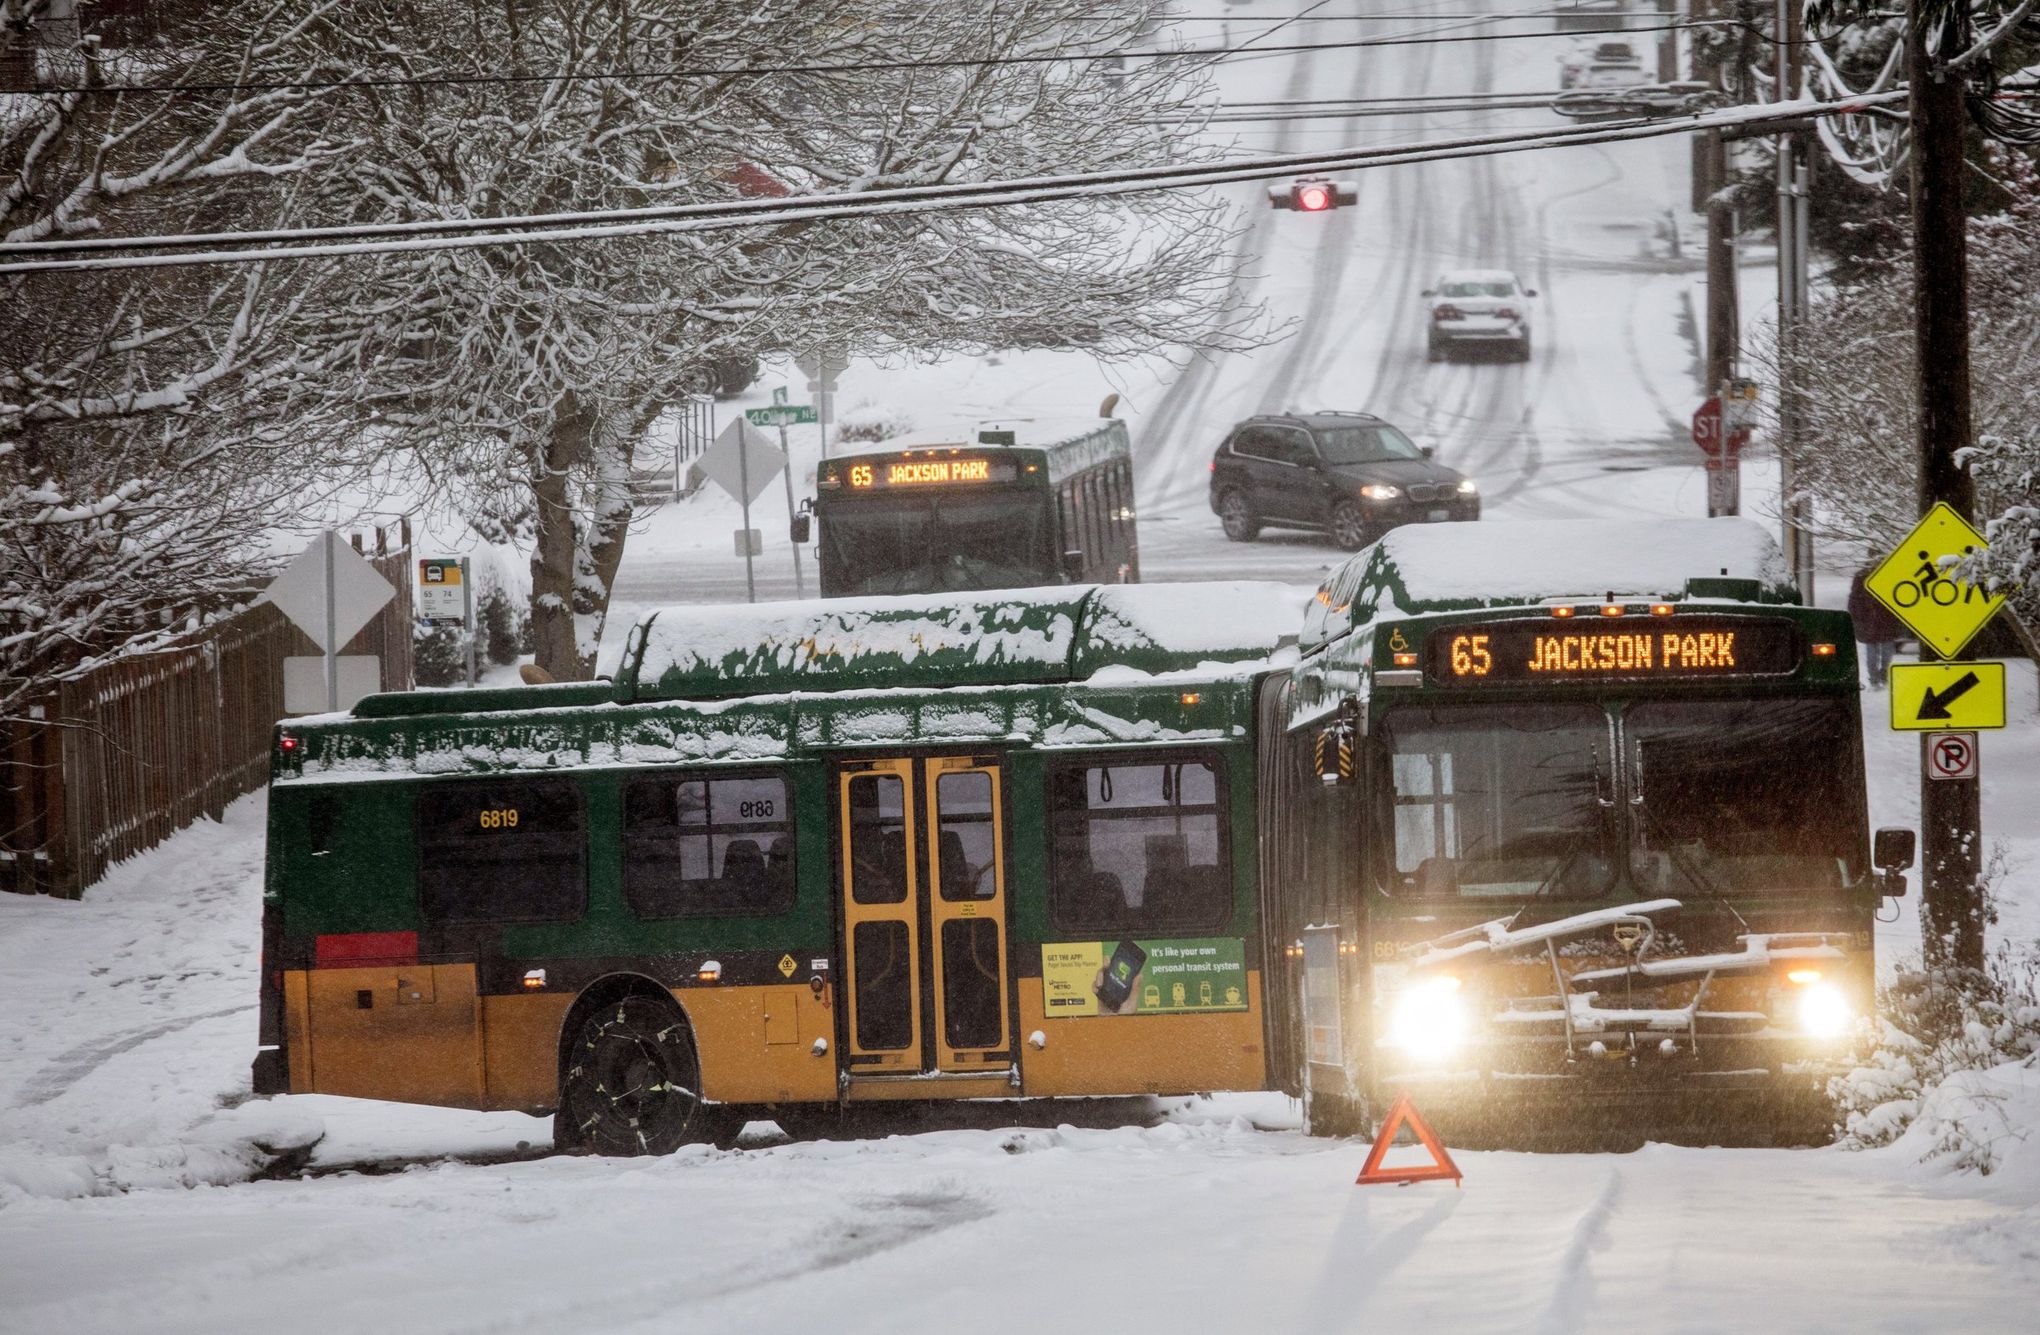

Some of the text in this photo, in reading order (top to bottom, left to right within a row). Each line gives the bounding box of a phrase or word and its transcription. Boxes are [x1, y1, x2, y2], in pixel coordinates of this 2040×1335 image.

[851, 461, 988, 486] 65 JACKSON PARK
[1452, 632, 1736, 677] 65 JACKSON PARK
[480, 810, 518, 829] 6819
[1047, 954, 1058, 962] GET
[1151, 947, 1217, 958] It's like your own
[1152, 962, 1240, 975] personal transit system
